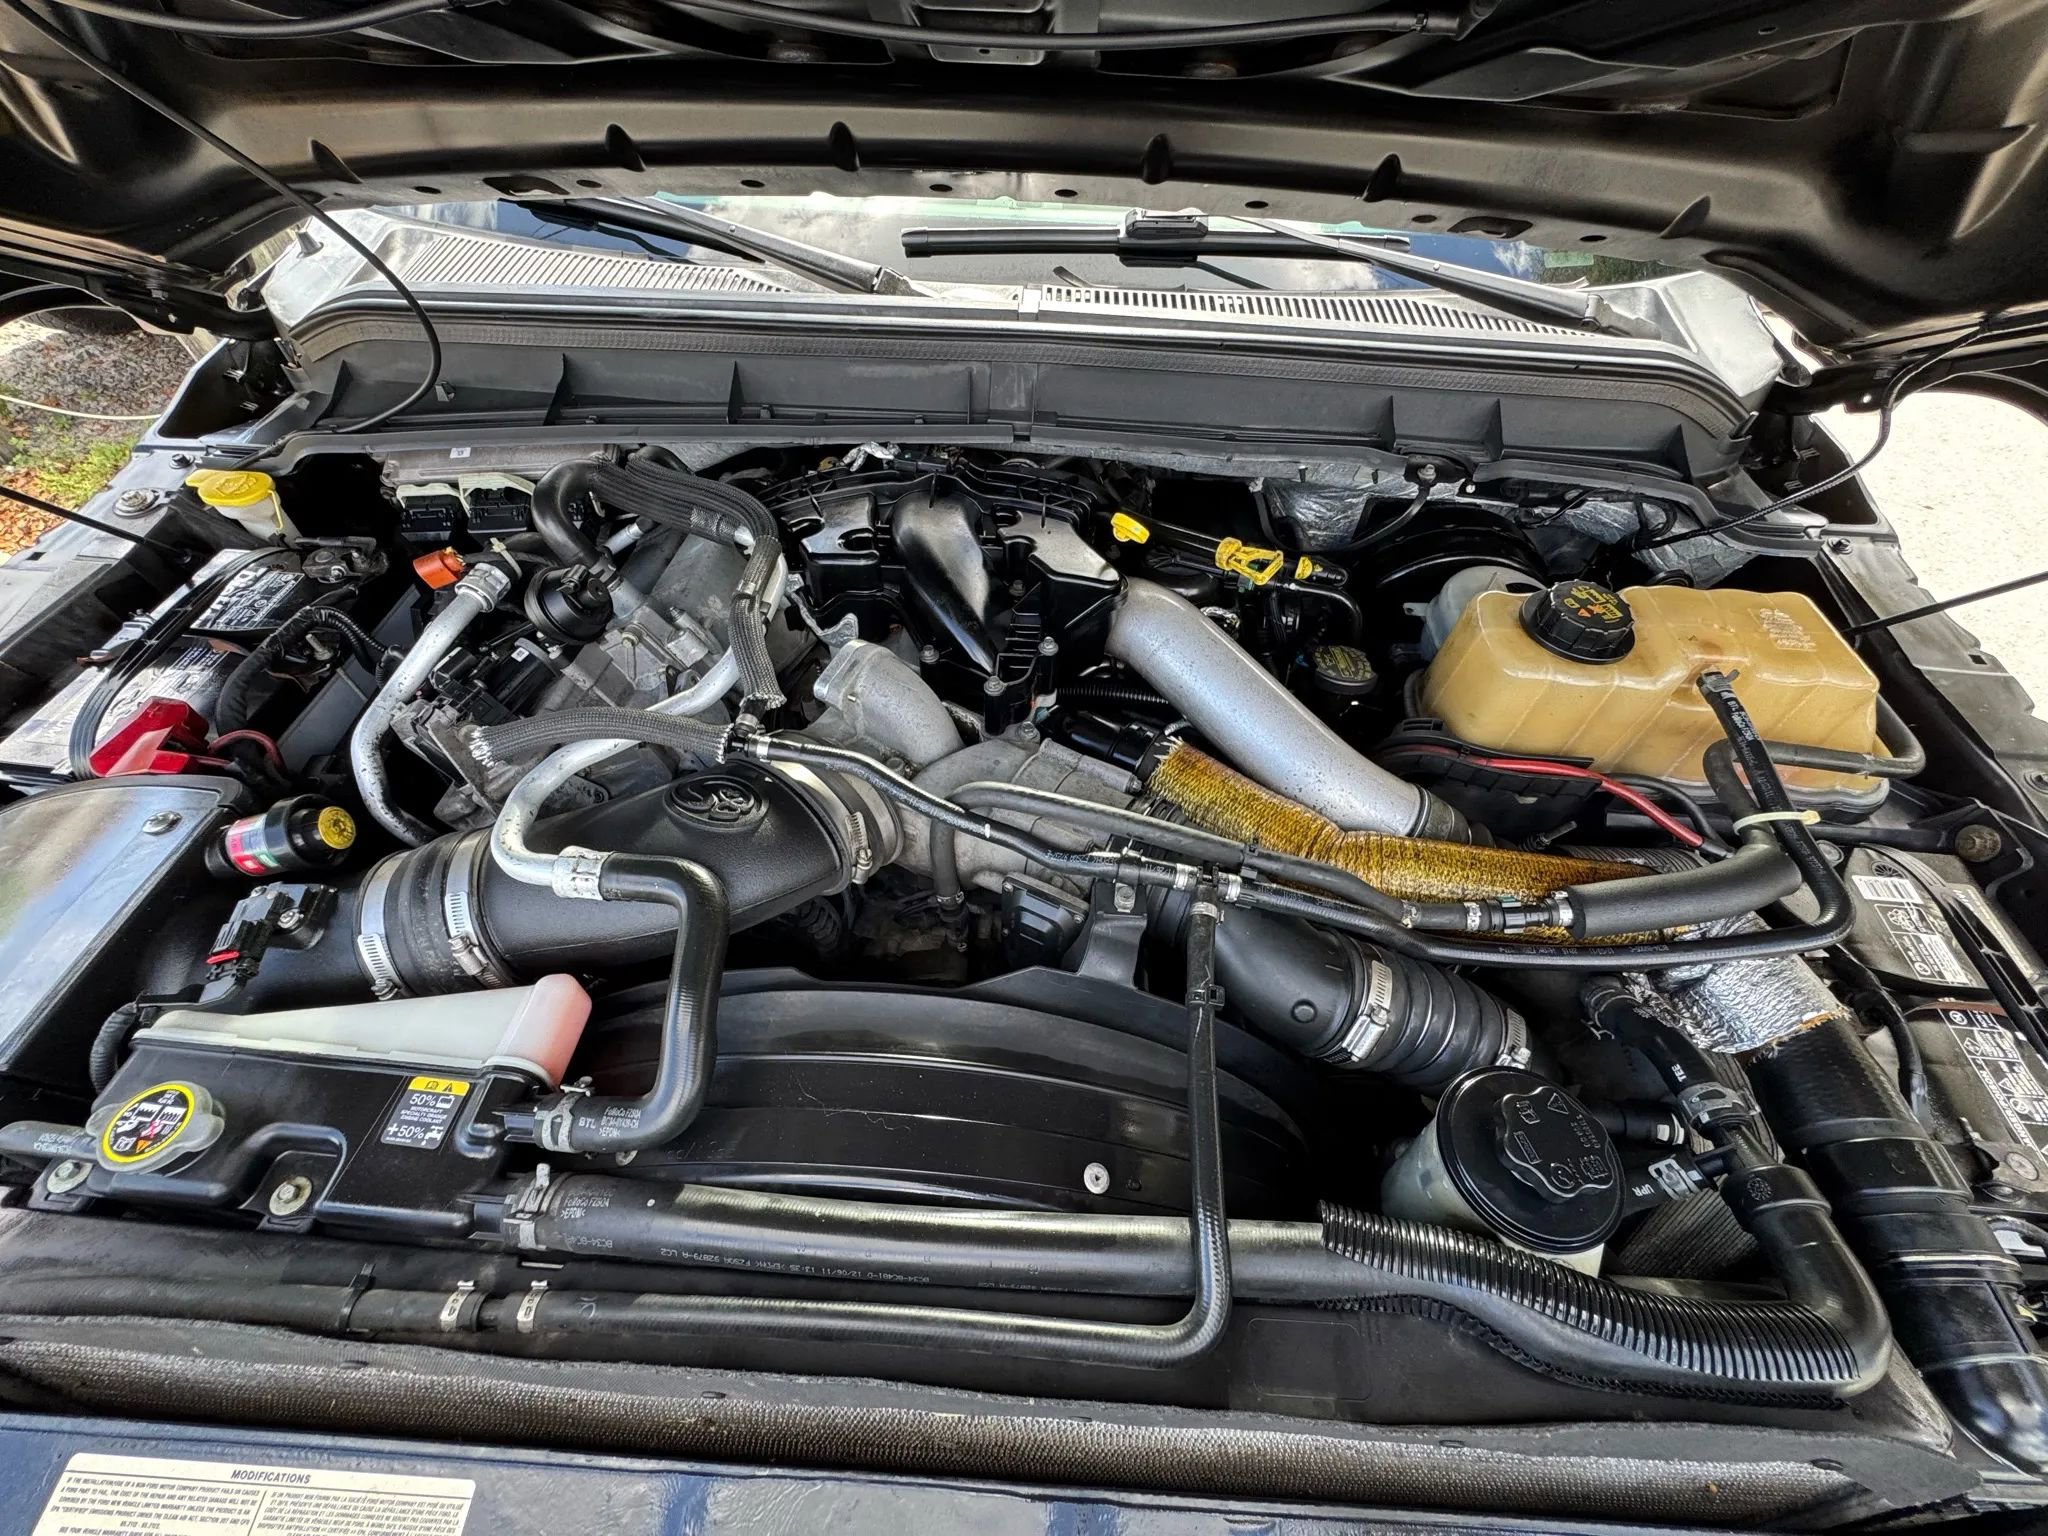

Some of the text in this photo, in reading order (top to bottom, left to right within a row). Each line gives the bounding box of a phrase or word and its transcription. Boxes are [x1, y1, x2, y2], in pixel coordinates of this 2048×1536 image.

[1671, 1063, 1688, 1083] TEE
[409, 1093, 437, 1107] 50%
[578, 1116, 597, 1129] BTL
[1631, 1183, 1654, 1197] UPR
[231, 1469, 311, 1484] MODIFICATIONS
